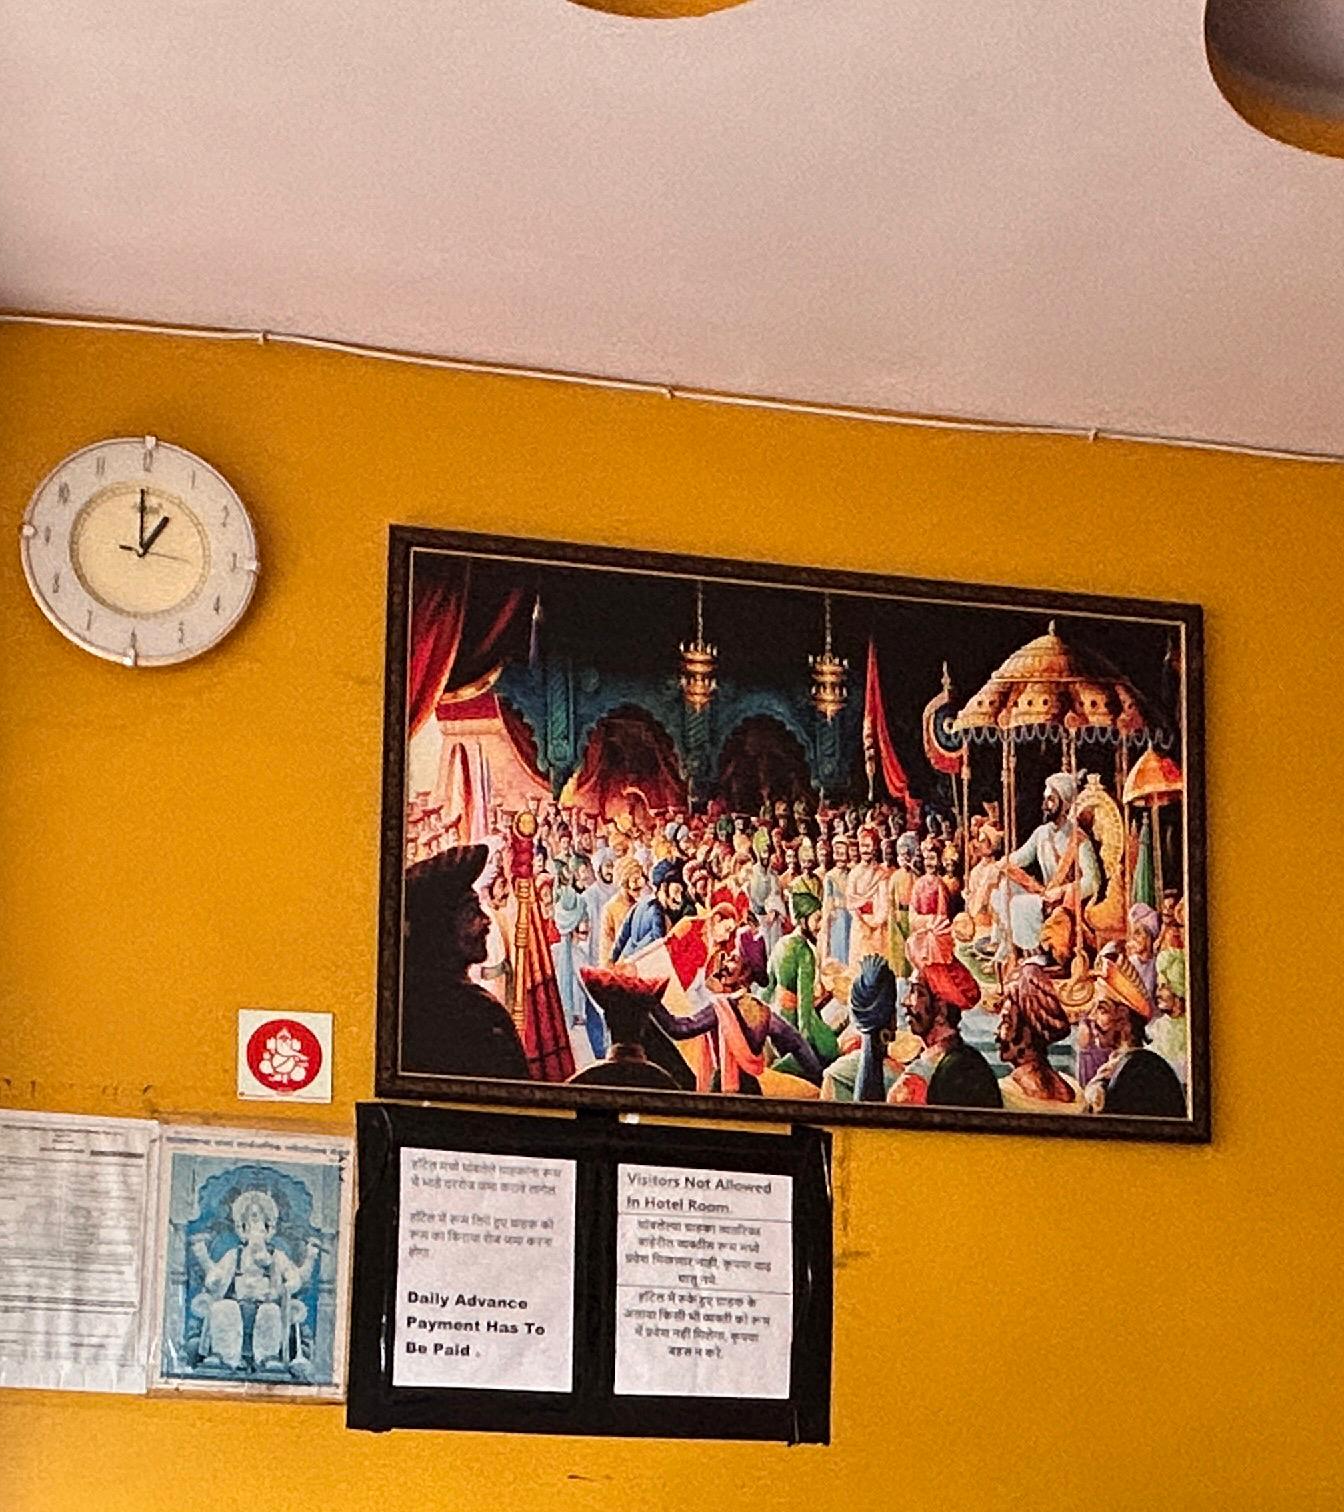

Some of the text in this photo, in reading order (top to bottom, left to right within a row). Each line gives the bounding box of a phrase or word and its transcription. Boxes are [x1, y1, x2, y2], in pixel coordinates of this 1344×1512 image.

[627, 1172, 771, 1194] Visitors Not Allowed
[627, 1196, 639, 1208] In
[645, 1197, 683, 1211] Hotel
[408, 1291, 528, 1309] Daily Advance
[407, 1316, 545, 1335] Payment Has To
